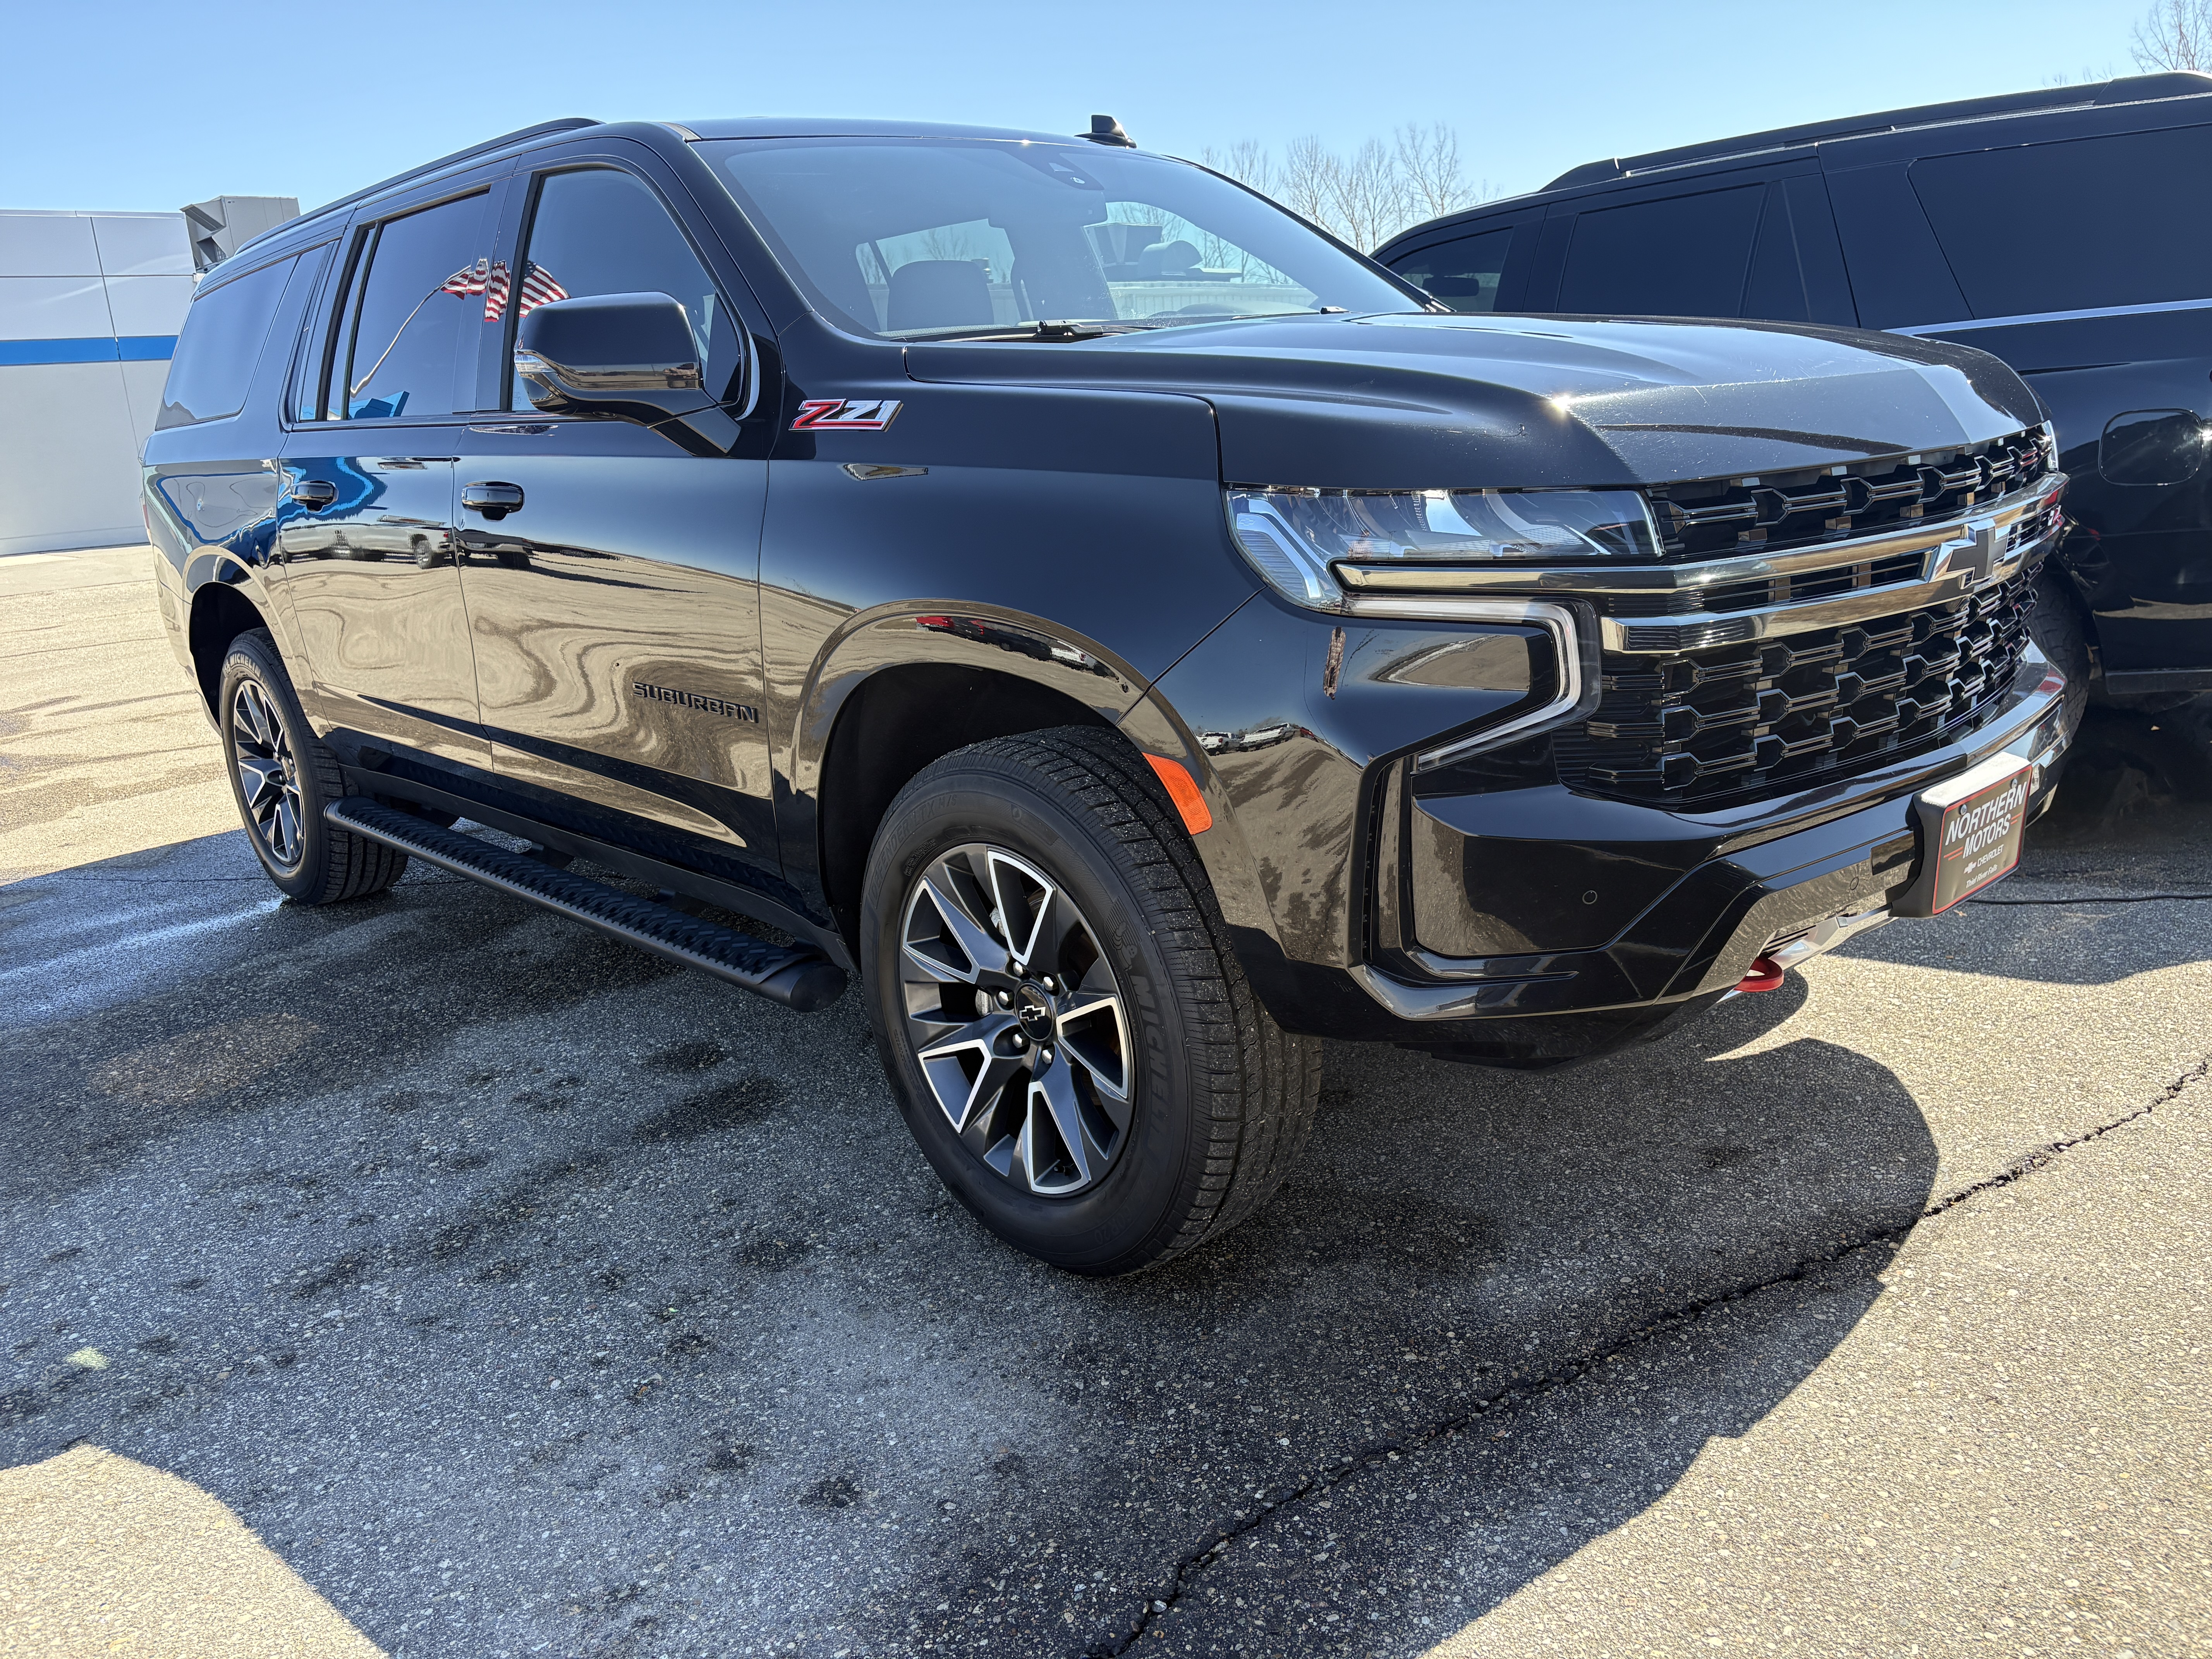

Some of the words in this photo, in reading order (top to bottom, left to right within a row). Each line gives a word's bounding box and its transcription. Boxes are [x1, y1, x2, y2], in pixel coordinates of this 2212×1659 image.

[788, 398, 902, 431] Z71
[230, 653, 261, 677] MICHELIN
[632, 681, 759, 723] SUBURBAN
[1945, 781, 2027, 846] NORTHERN
[872, 819, 910, 900] DEFENDER
[913, 799, 934, 827] LTX
[938, 794, 957, 808] M/S
[1962, 813, 2011, 859] MOTORS
[1977, 844, 2004, 867] CHEVROLET
[1966, 875, 1977, 889] Thief
[1976, 871, 1989, 882] River
[1987, 864, 1998, 875] Falls
[1130, 975, 1169, 1158] MICHELIN
